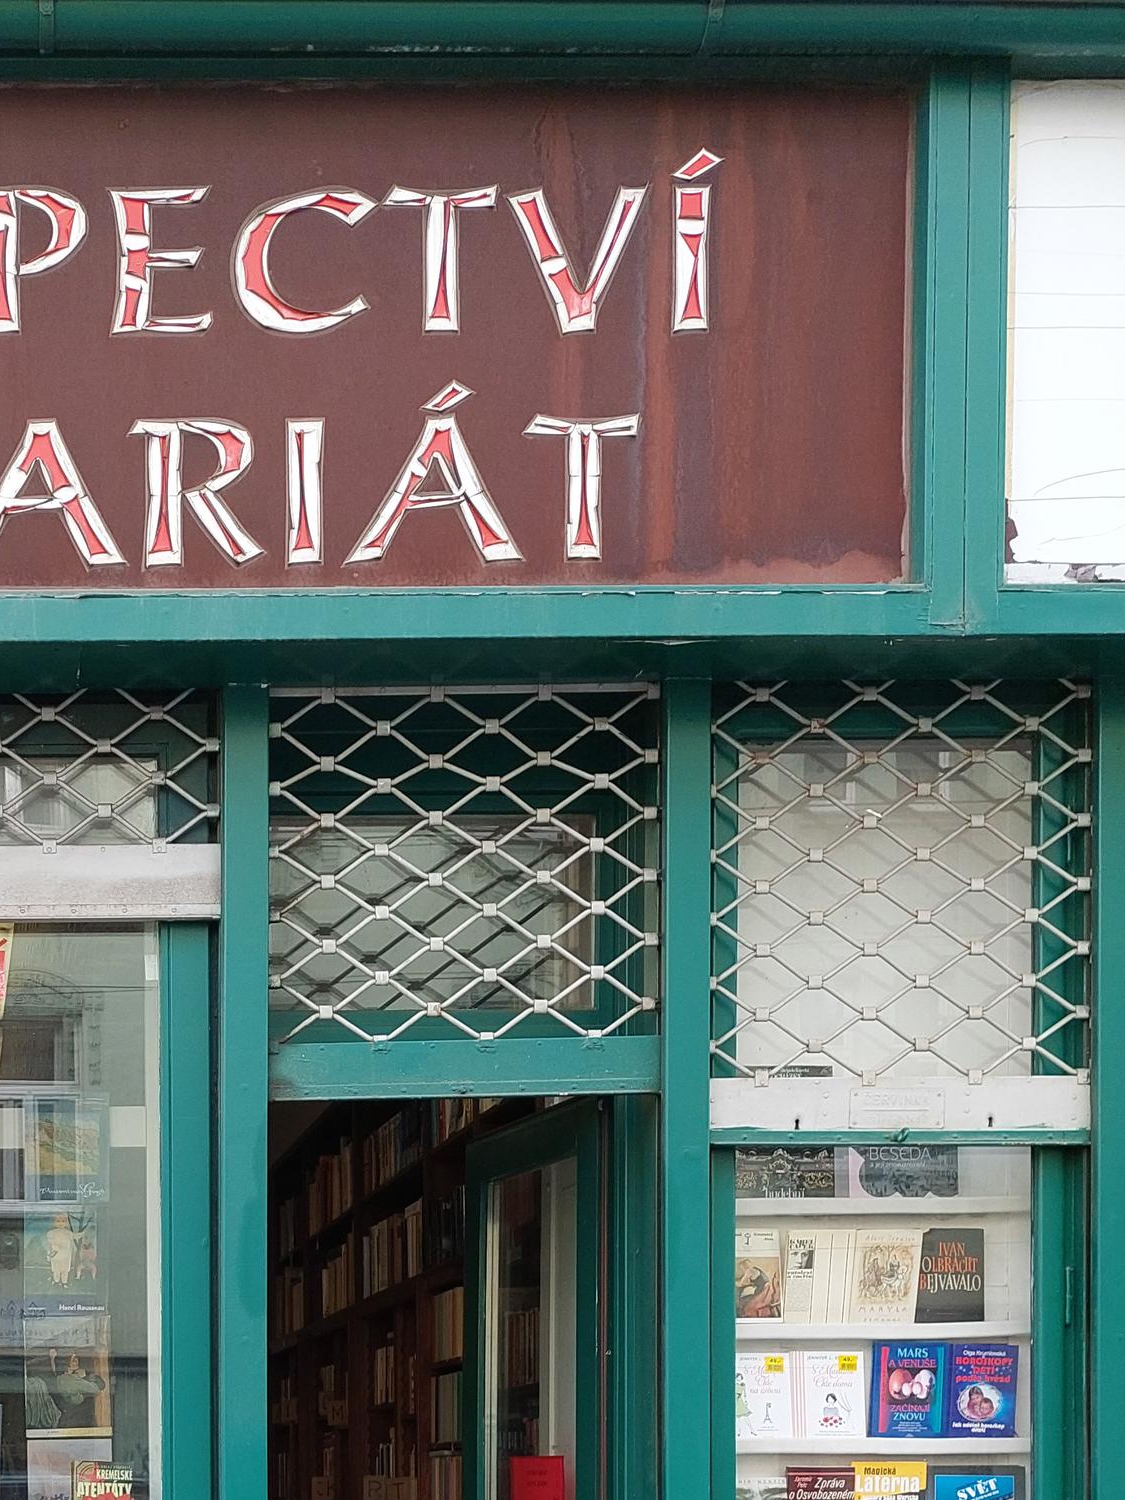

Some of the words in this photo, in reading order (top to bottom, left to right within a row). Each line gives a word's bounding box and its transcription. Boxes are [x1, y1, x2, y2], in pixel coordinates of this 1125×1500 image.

[869, 1146, 932, 1161] BESEDA
[938, 1242, 966, 1257] IVAN
[897, 1347, 929, 1358] MARS
[893, 1412, 926, 1421] ZNOVU
[95, 1467, 133, 1481] KREMELSKÉ
[863, 1466, 897, 1477] Magická
[76, 1480, 133, 1498] ATENTÁTY
[814, 1477, 846, 1489] Zpráva
[854, 1475, 921, 1494] Laterna
[796, 1488, 855, 1500] Osvobozeném
